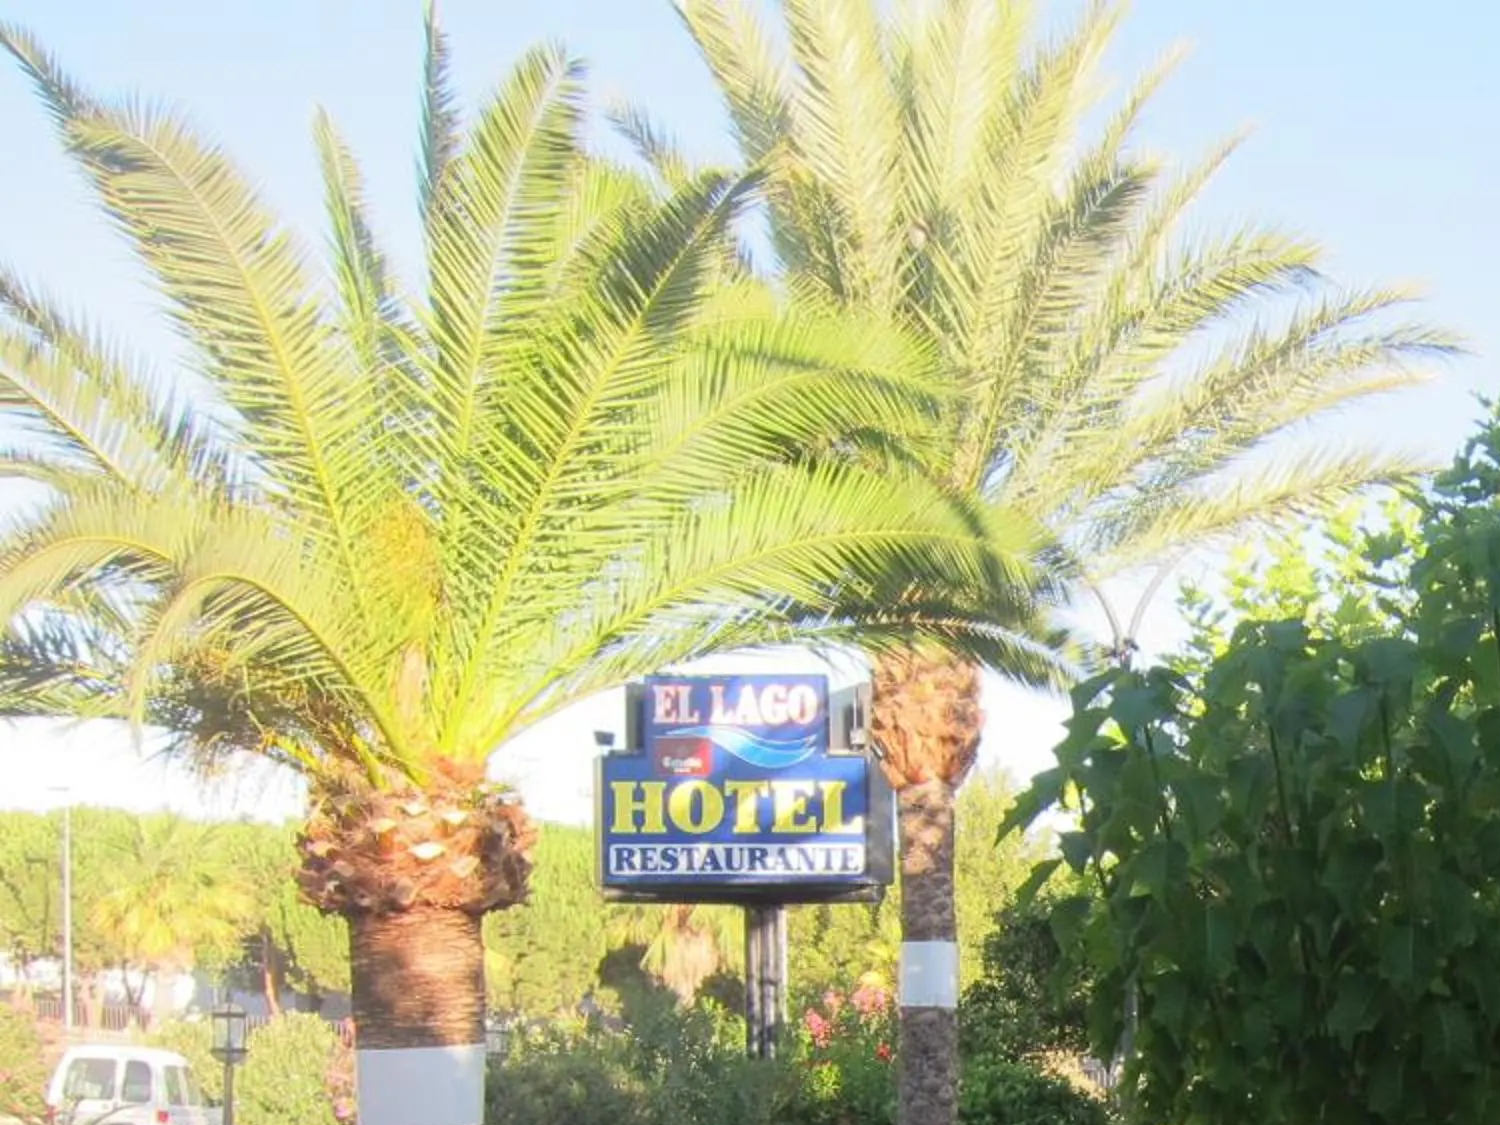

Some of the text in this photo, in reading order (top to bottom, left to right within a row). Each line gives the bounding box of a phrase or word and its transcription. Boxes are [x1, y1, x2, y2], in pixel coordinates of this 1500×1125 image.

[652, 684, 818, 725] EL LAGO
[610, 780, 863, 834] HOTEL
[614, 847, 860, 872] RESTAURANTE
